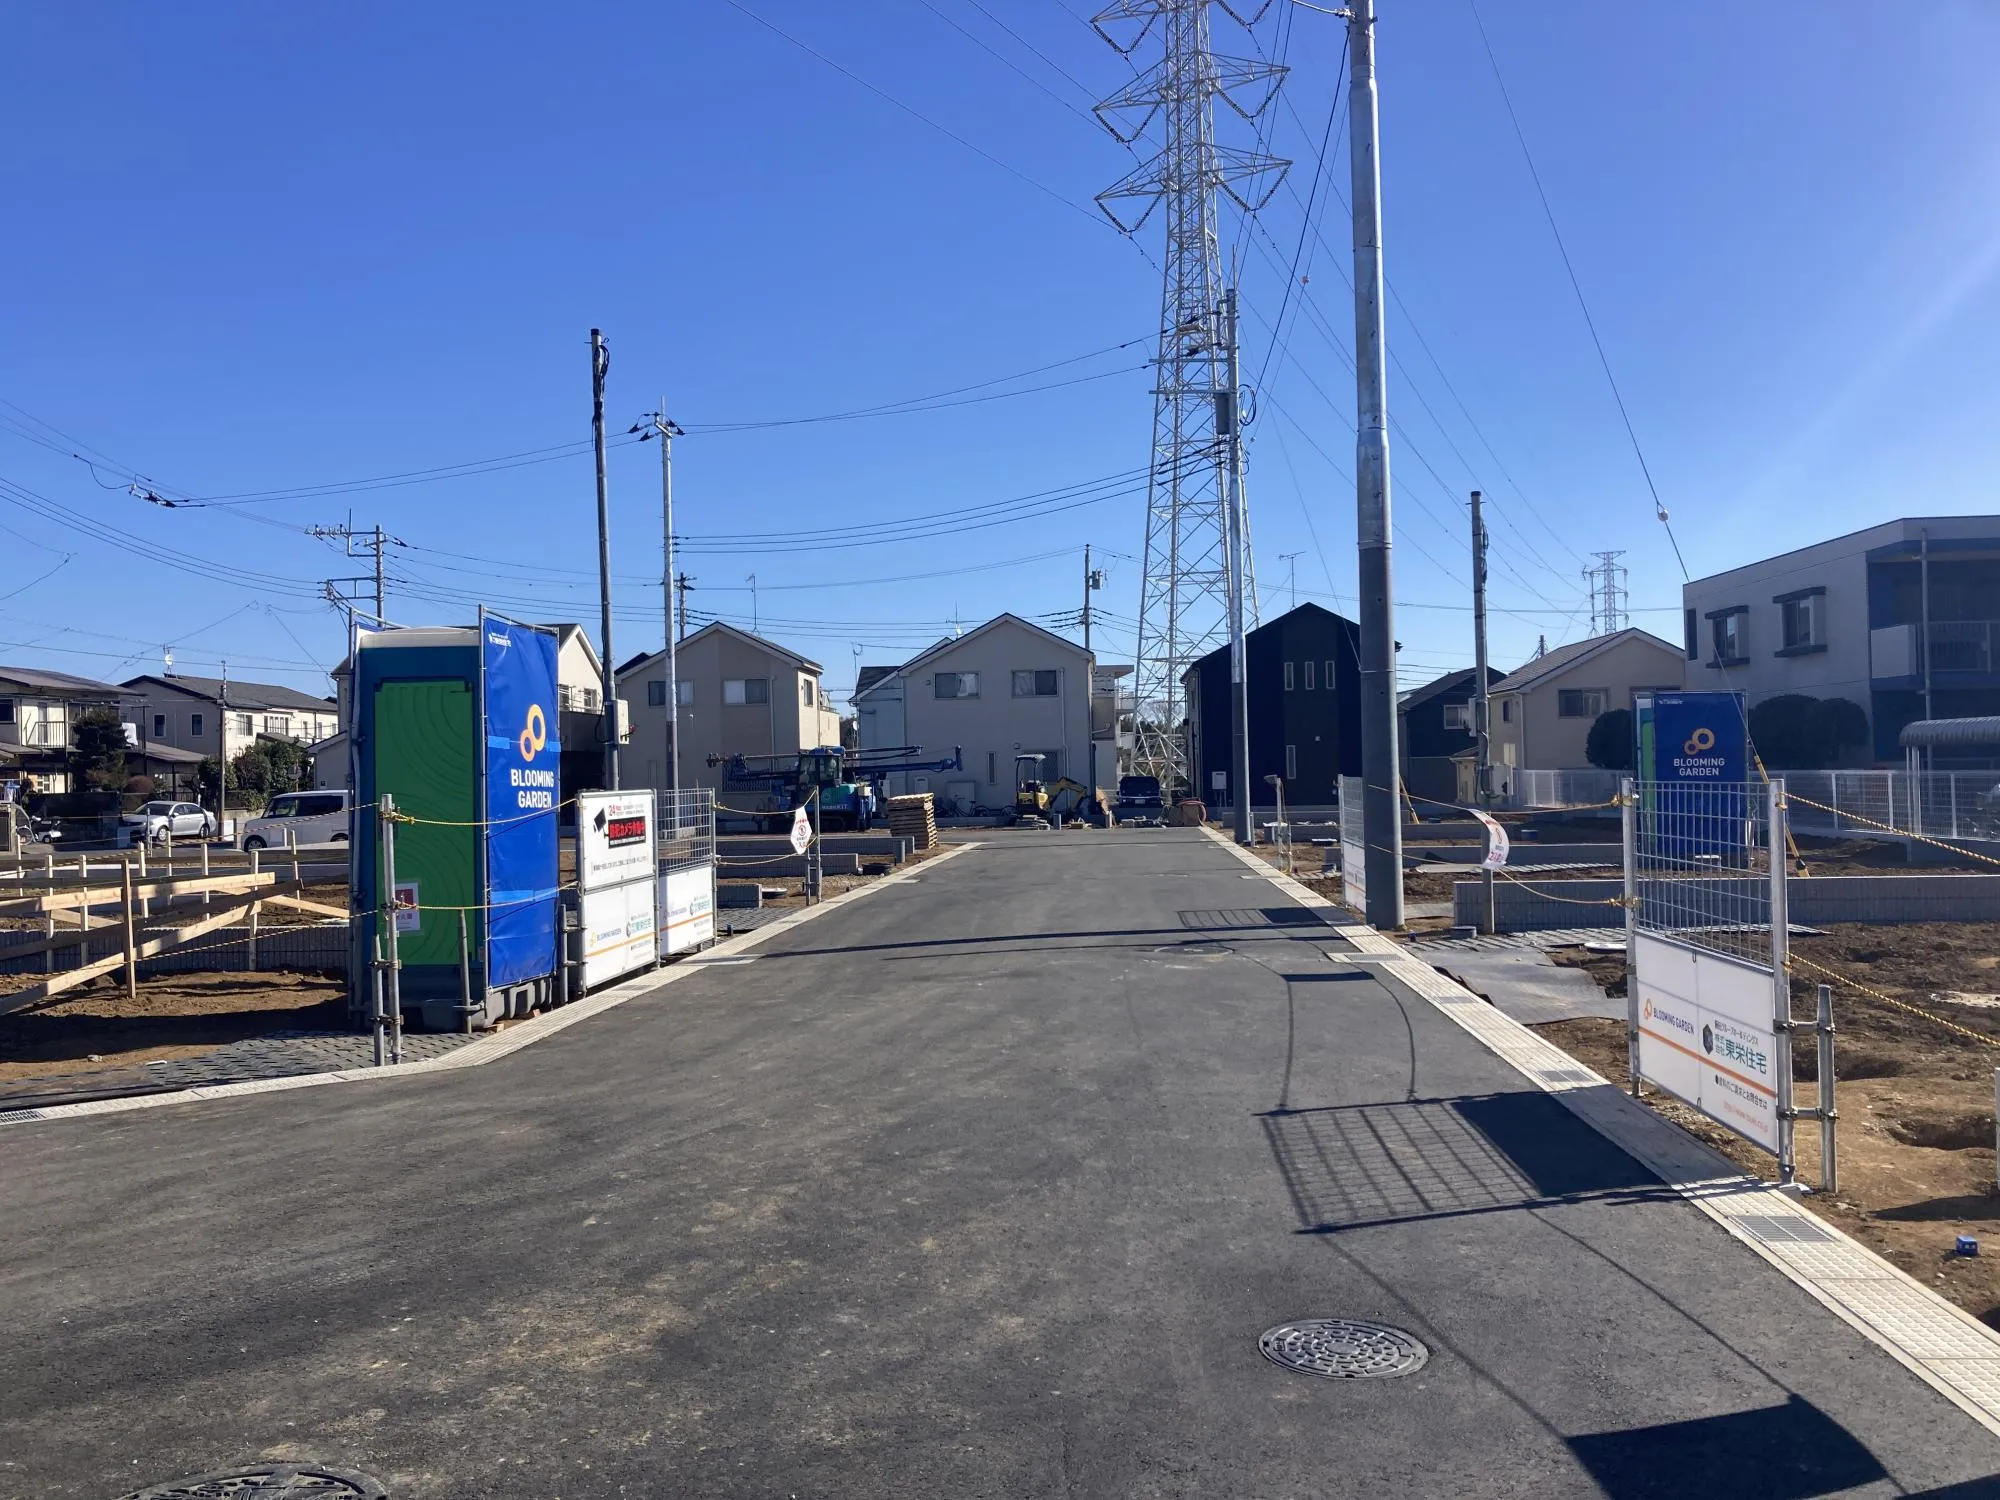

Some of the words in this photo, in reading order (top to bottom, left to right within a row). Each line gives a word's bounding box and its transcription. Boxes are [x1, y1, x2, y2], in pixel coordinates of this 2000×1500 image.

[1674, 758, 1725, 766] BLOOMING
[511, 768, 554, 788] BLOOMING
[1679, 768, 1719, 776] GARDEN
[518, 791, 552, 809] GARDEN
[1653, 1007, 1675, 1026] BLOOMING
[1675, 1017, 1695, 1034] GARDEN
[1725, 1039, 1767, 1075] 東栄住宅
